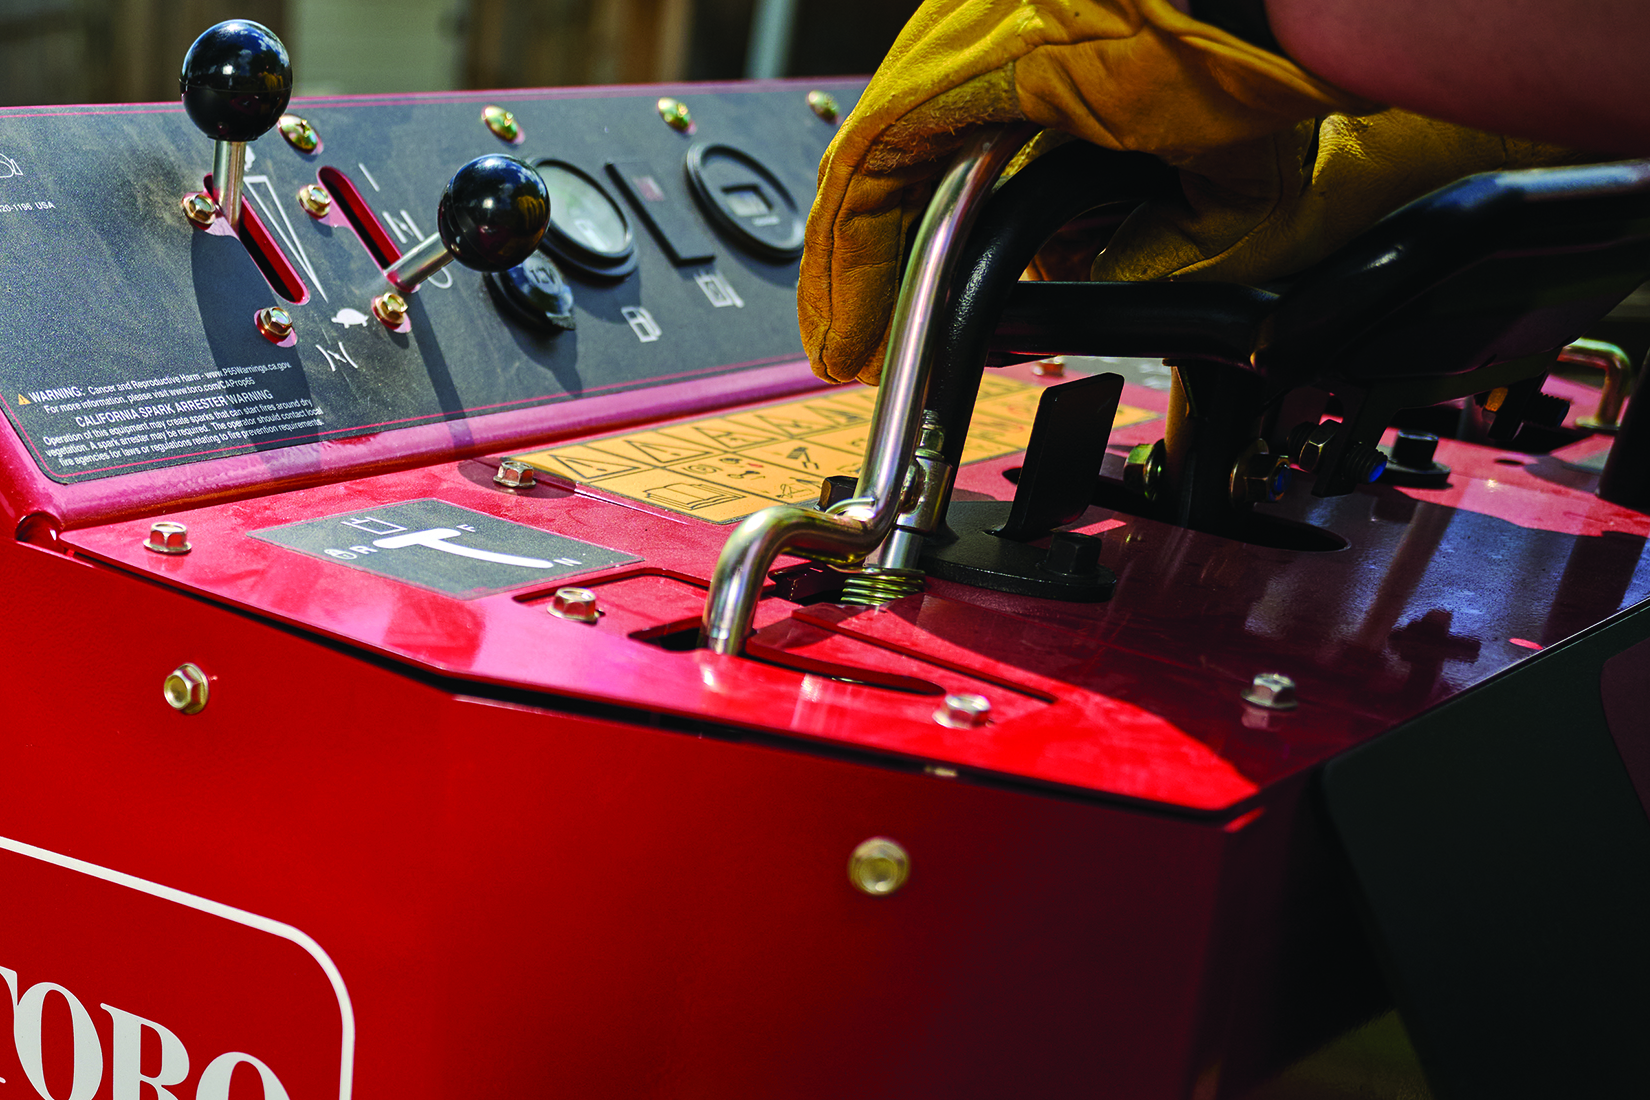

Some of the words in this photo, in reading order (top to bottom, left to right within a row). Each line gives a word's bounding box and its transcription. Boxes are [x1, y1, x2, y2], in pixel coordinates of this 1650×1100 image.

[34, 201, 56, 210] USA
[28, 386, 86, 403] WARNING:
[87, 385, 116, 395] Cancer
[116, 381, 132, 391] and
[130, 375, 181, 390] Reproductive
[179, 373, 201, 383] Harm
[43, 404, 60, 414] For
[59, 401, 82, 412] more
[127, 392, 153, 405] please
[151, 388, 170, 399] visit
[42, 432, 85, 447] Operation
[83, 429, 94, 440] of
[91, 428, 109, 439] this
[108, 421, 151, 437] equipment
[149, 419, 168, 430] may
[166, 416, 191, 427] create
[189, 411, 215, 425] sparks
[212, 409, 231, 420] that
[229, 408, 244, 418] can
[243, 404, 261, 415] start
[258, 402, 277, 413] fires
[275, 398, 301, 410] around
[299, 397, 313, 407] dry
[75, 409, 141, 428] CALIFORNIA
[138, 403, 176, 418] SPARK
[174, 395, 229, 413] ARRESTER
[226, 389, 274, 405] WARNING
[44, 443, 91, 459] vegetation.
[89, 440, 99, 451] A
[97, 437, 120, 451] spark
[119, 434, 150, 446] arrester
[149, 430, 168, 442] may
[165, 428, 179, 439] be
[177, 423, 211, 437] required.
[210, 420, 228, 431] The
[226, 417, 257, 430] operator
[256, 411, 282, 424] should
[280, 407, 307, 420] contact
[304, 405, 324, 416] local
[58, 457, 76, 468] fire
[73, 452, 111, 467] agencies
[108, 449, 122, 460] for
[120, 446, 141, 457] laws
[140, 445, 150, 454] or
[149, 437, 193, 454] regulations
[191, 434, 222, 447] relating
[218, 432, 230, 442] to
[226, 429, 243, 440] fire
[240, 424, 279, 441] prevention
